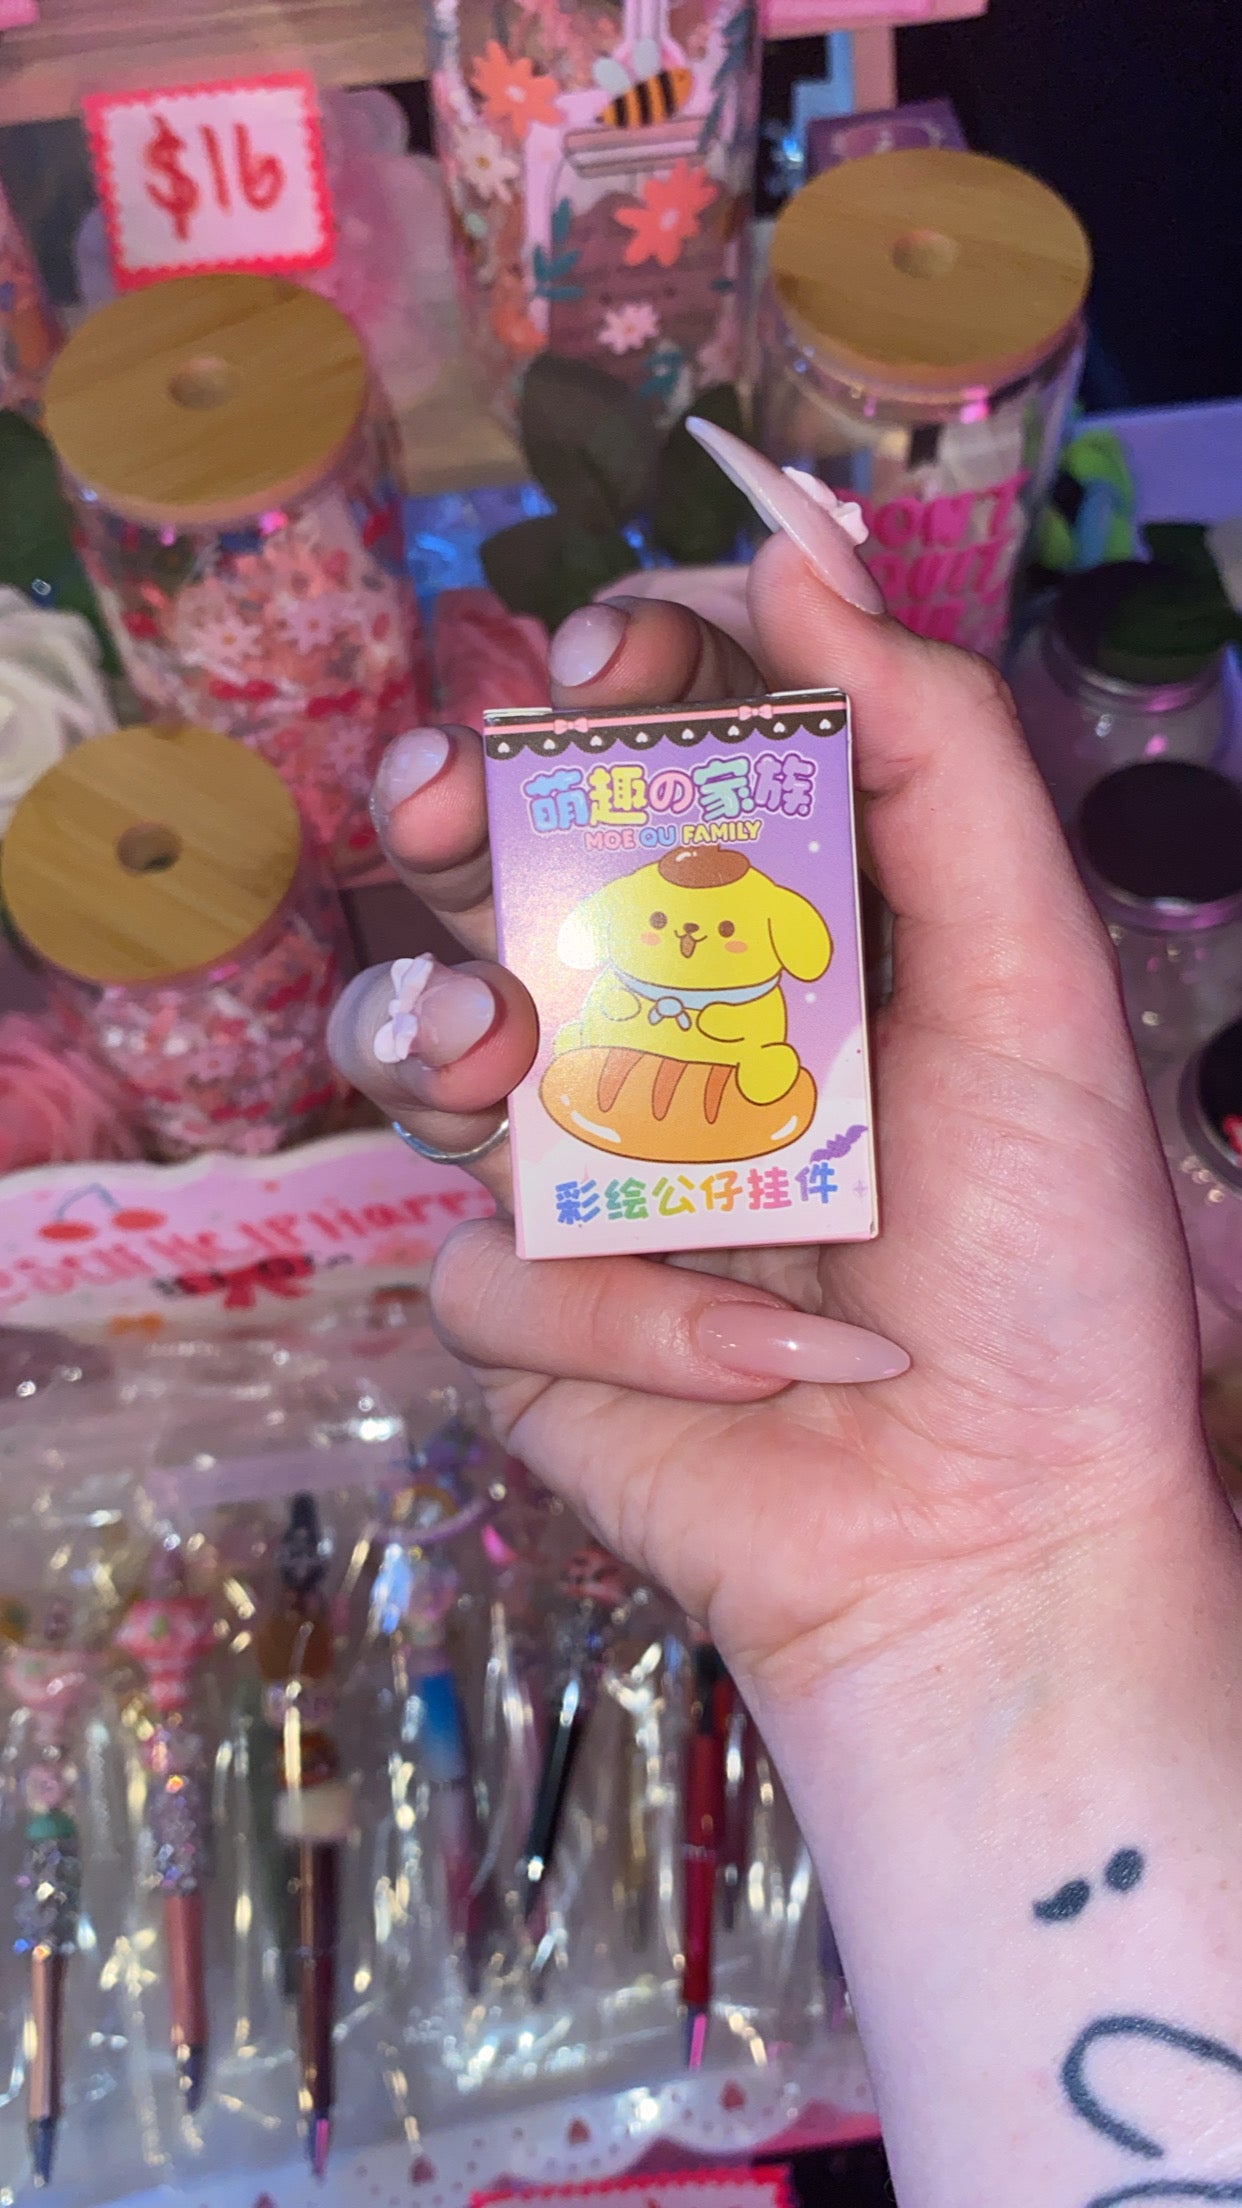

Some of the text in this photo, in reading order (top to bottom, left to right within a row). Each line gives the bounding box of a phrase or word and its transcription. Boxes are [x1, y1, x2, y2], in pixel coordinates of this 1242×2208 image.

[143, 114, 287, 244] $16
[523, 752, 817, 833] 萌趣の家族
[584, 829, 635, 850] MOE
[681, 819, 762, 845] FAMILY
[555, 1161, 839, 1225] 彩绘公仔挂件
